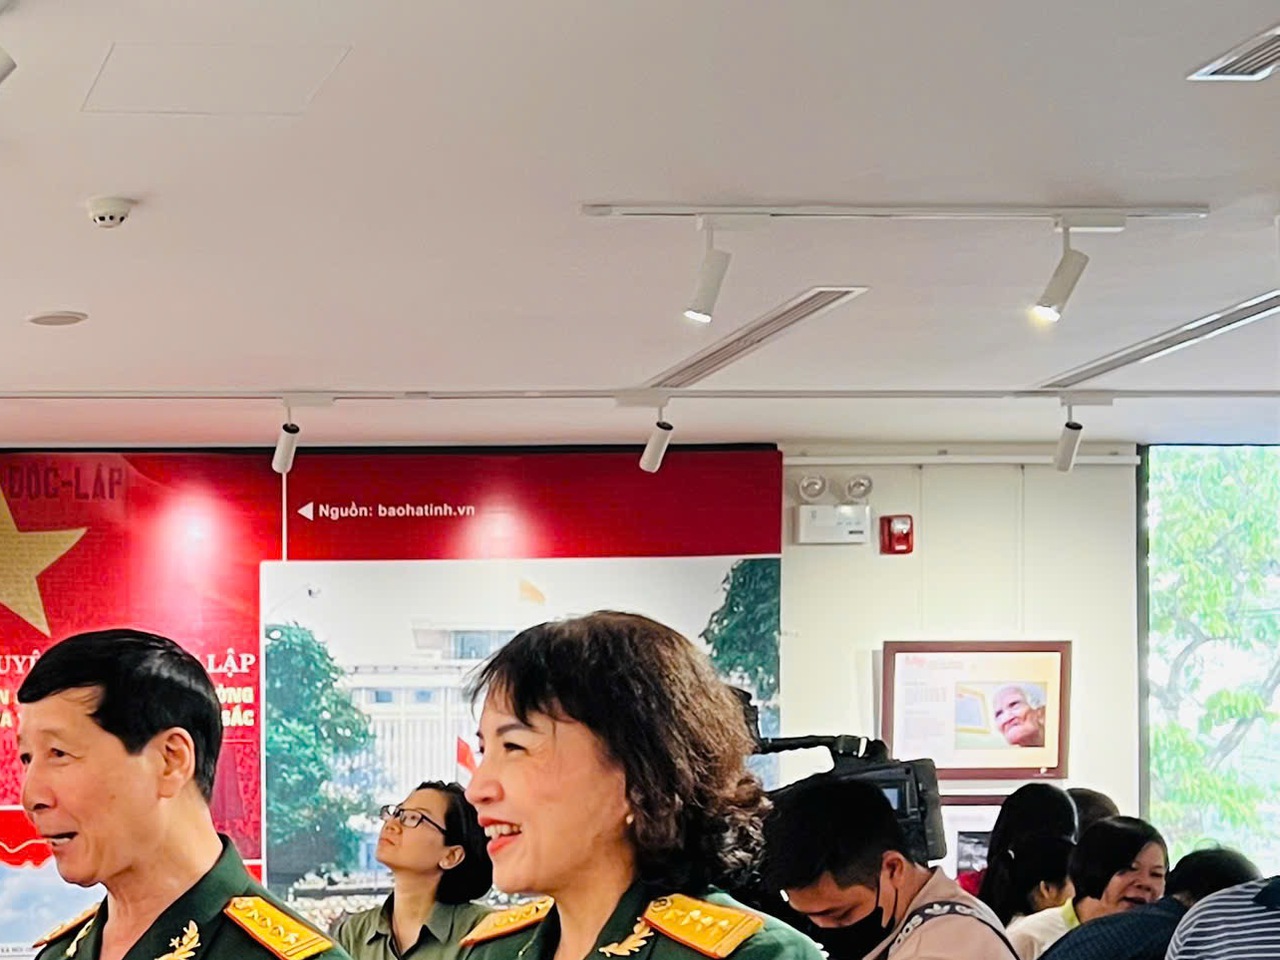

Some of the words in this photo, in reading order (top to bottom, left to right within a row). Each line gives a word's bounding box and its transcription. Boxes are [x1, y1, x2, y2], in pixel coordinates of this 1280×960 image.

[319, 501, 373, 520] Nguồn:
[378, 503, 476, 517] baohatinh.vn
[207, 648, 256, 678] LẬP
